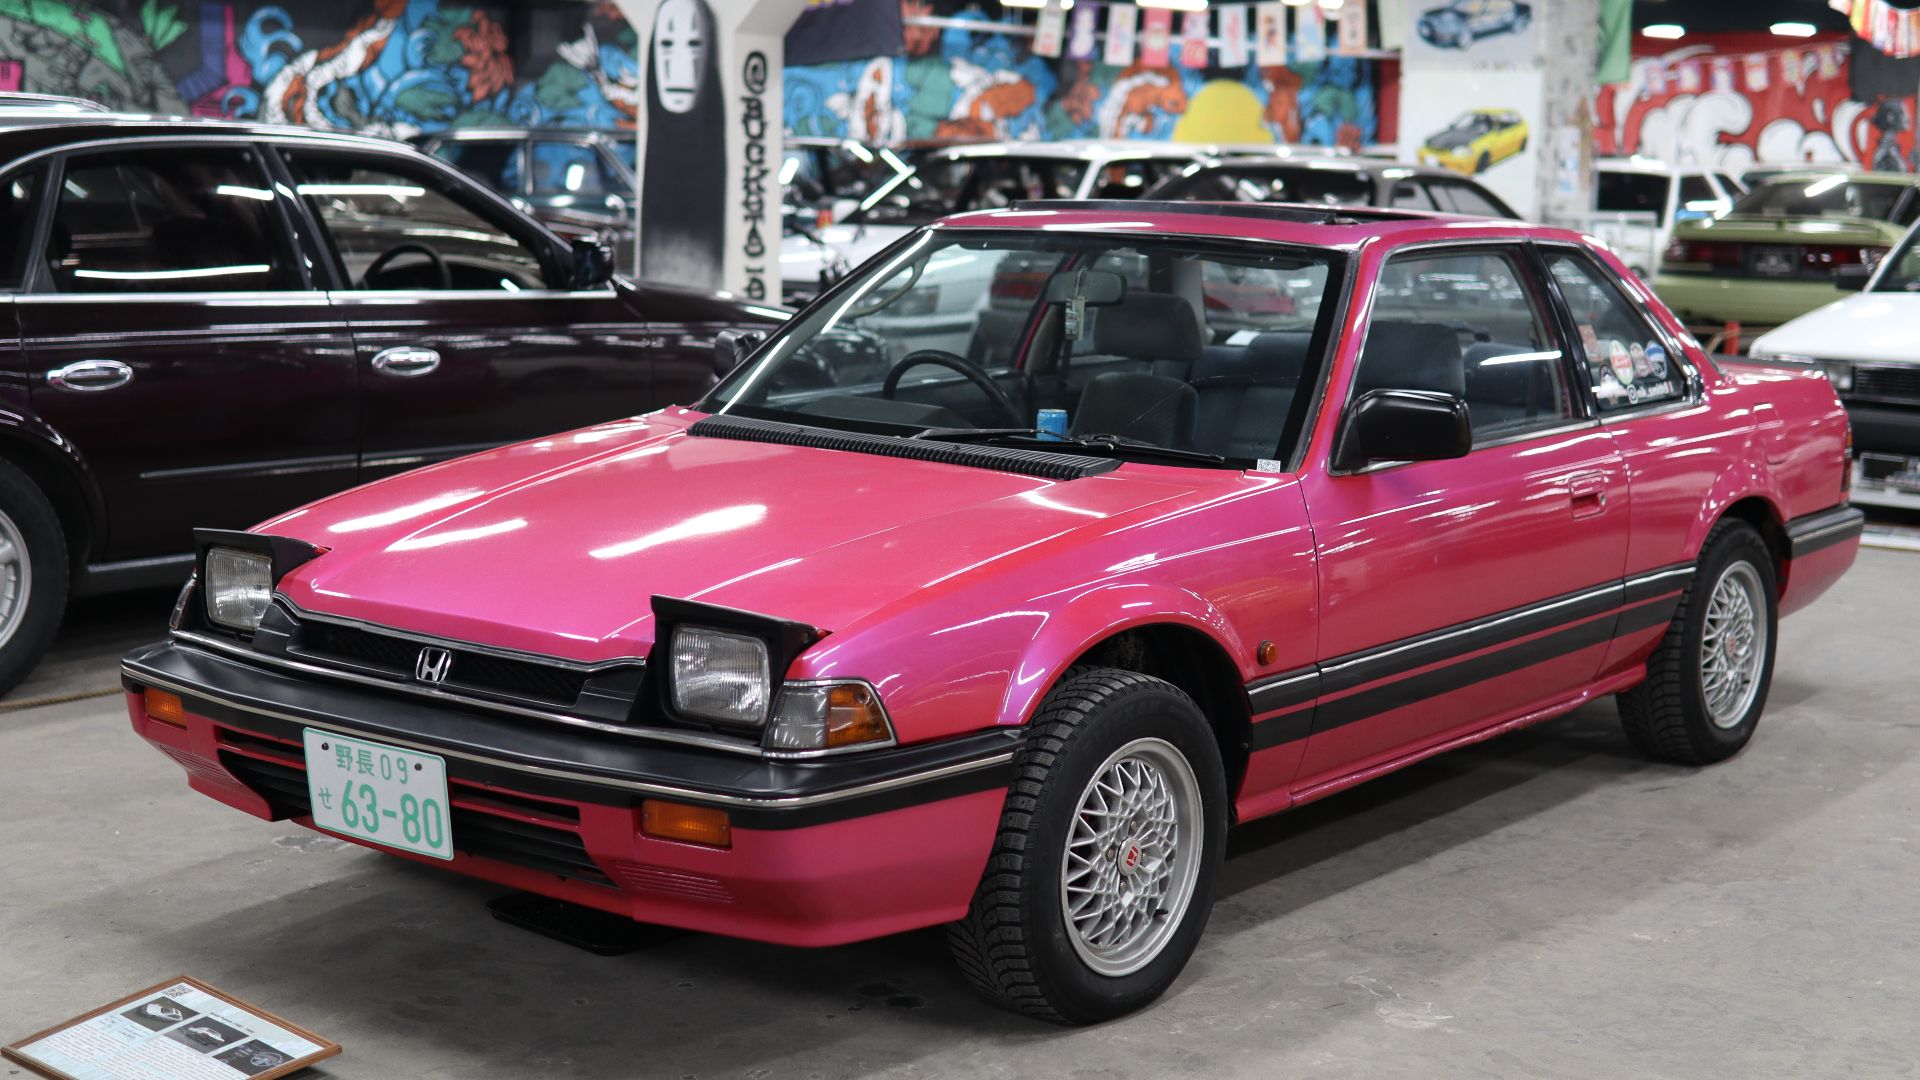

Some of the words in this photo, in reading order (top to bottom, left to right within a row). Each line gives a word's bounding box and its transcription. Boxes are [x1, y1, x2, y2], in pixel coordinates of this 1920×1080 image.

[380, 753, 409, 785] 09
[318, 787, 332, 810] せ
[341, 779, 444, 849] 63-80
